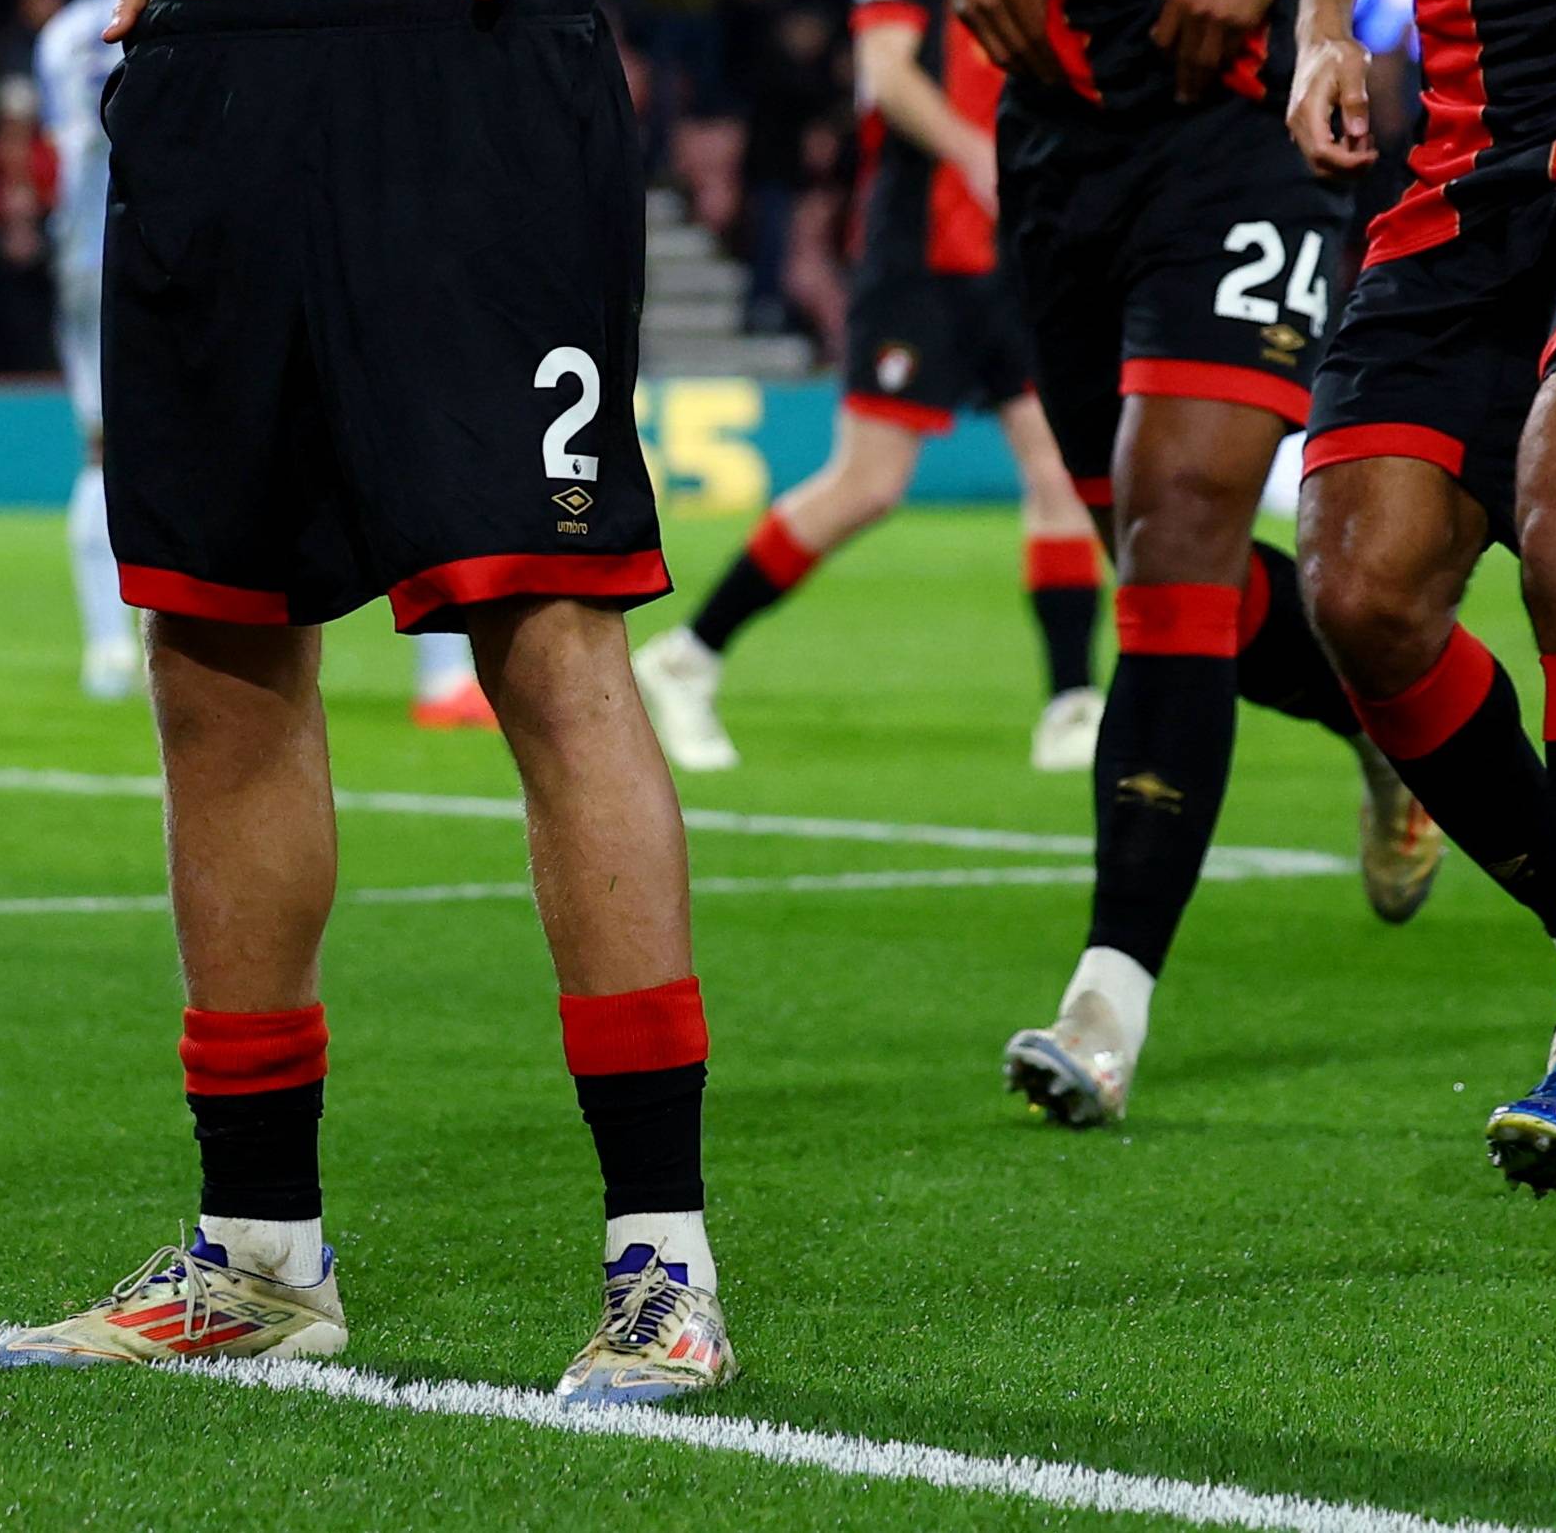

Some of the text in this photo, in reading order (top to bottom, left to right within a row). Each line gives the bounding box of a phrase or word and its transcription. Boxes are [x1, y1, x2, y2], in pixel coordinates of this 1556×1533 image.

[1213, 220, 1328, 338] 24
[534, 346, 600, 481] 2
[557, 520, 588, 534] umbro
